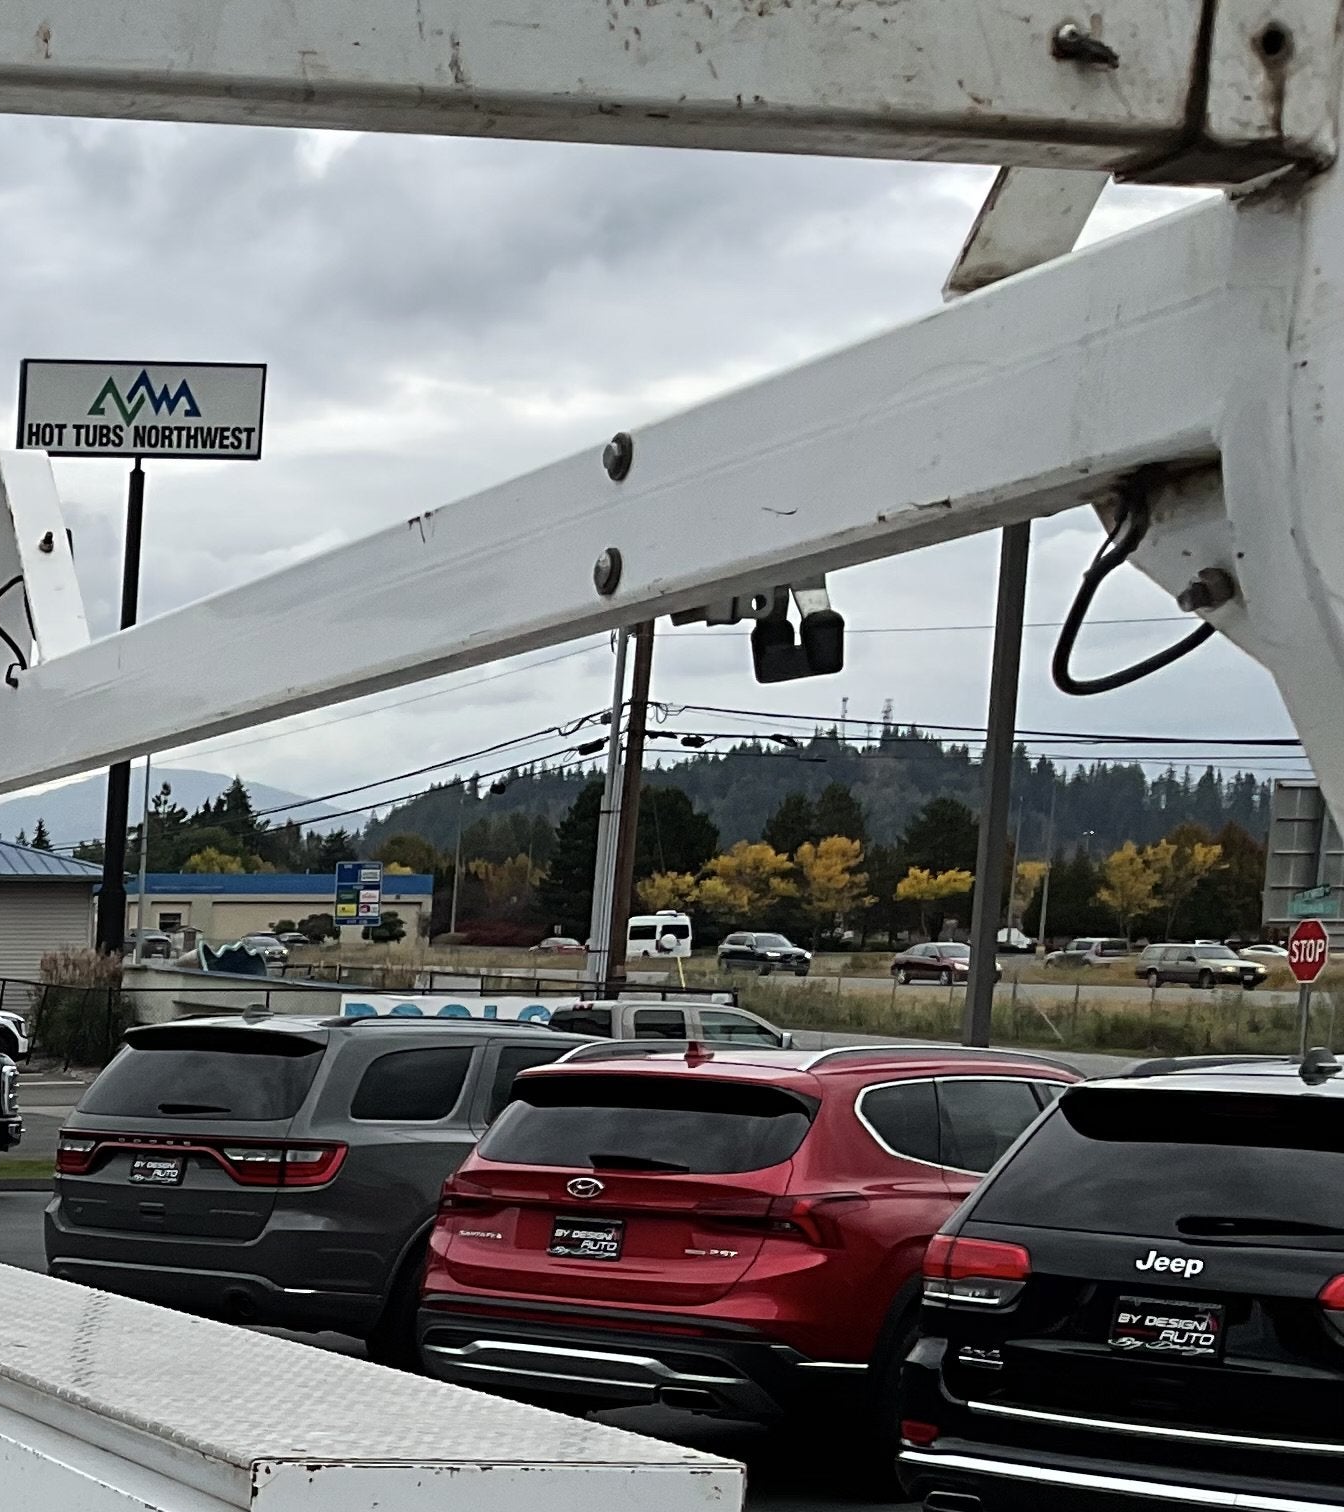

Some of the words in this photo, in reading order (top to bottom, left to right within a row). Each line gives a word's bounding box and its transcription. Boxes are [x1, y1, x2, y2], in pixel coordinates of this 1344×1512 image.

[27, 422, 67, 447] HOT
[72, 423, 124, 448] TUBS
[132, 424, 256, 450] NORTHWEST
[1291, 939, 1325, 963] STOP
[152, 1169, 179, 1177] AUTO
[554, 1228, 571, 1237] BY
[580, 1240, 618, 1251] AUTO
[1135, 1250, 1204, 1278] Jeep
[1117, 1312, 1142, 1324] BY
[1144, 1315, 1208, 1331] DESIGN
[1159, 1330, 1215, 1346] AUTO
